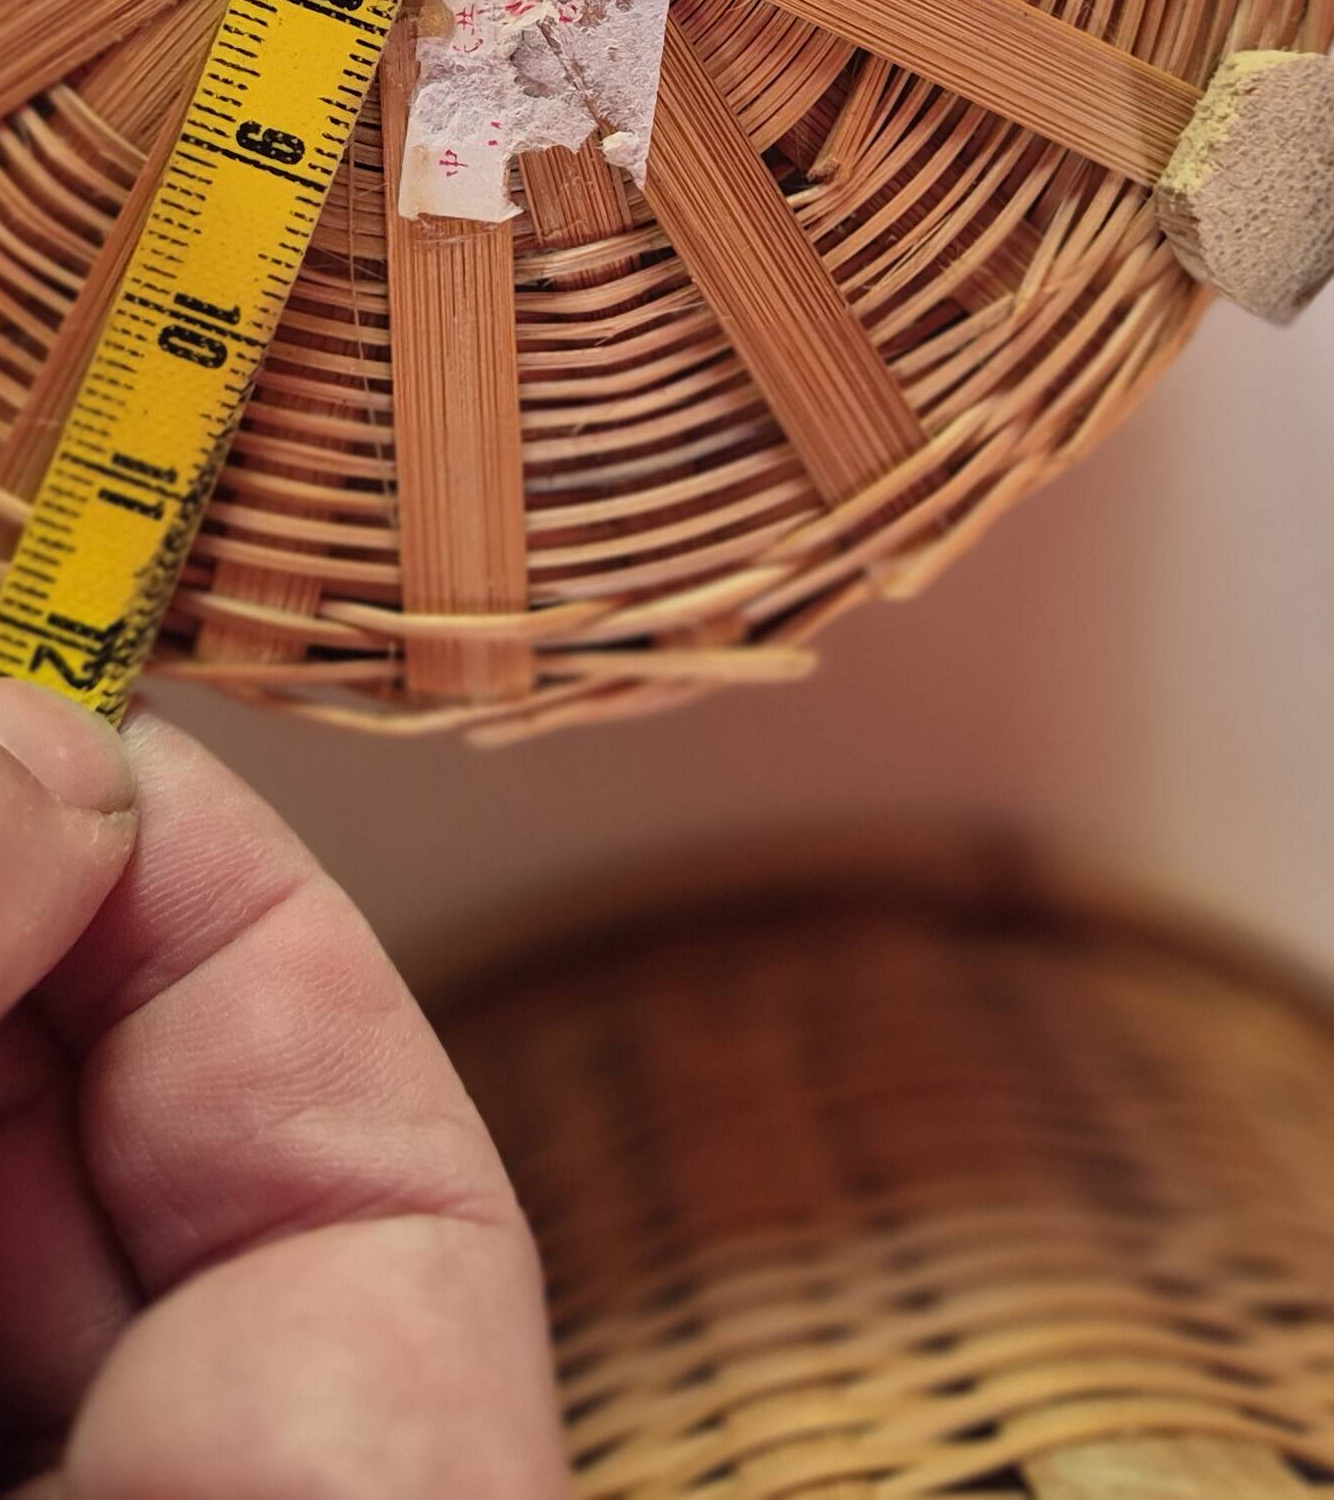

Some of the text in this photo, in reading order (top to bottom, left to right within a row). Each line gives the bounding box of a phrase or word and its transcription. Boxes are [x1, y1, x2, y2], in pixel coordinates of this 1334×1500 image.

[236, 119, 306, 165] 9
[157, 293, 241, 369] 10
[97, 453, 178, 521] 11
[29, 612, 125, 691] 12
